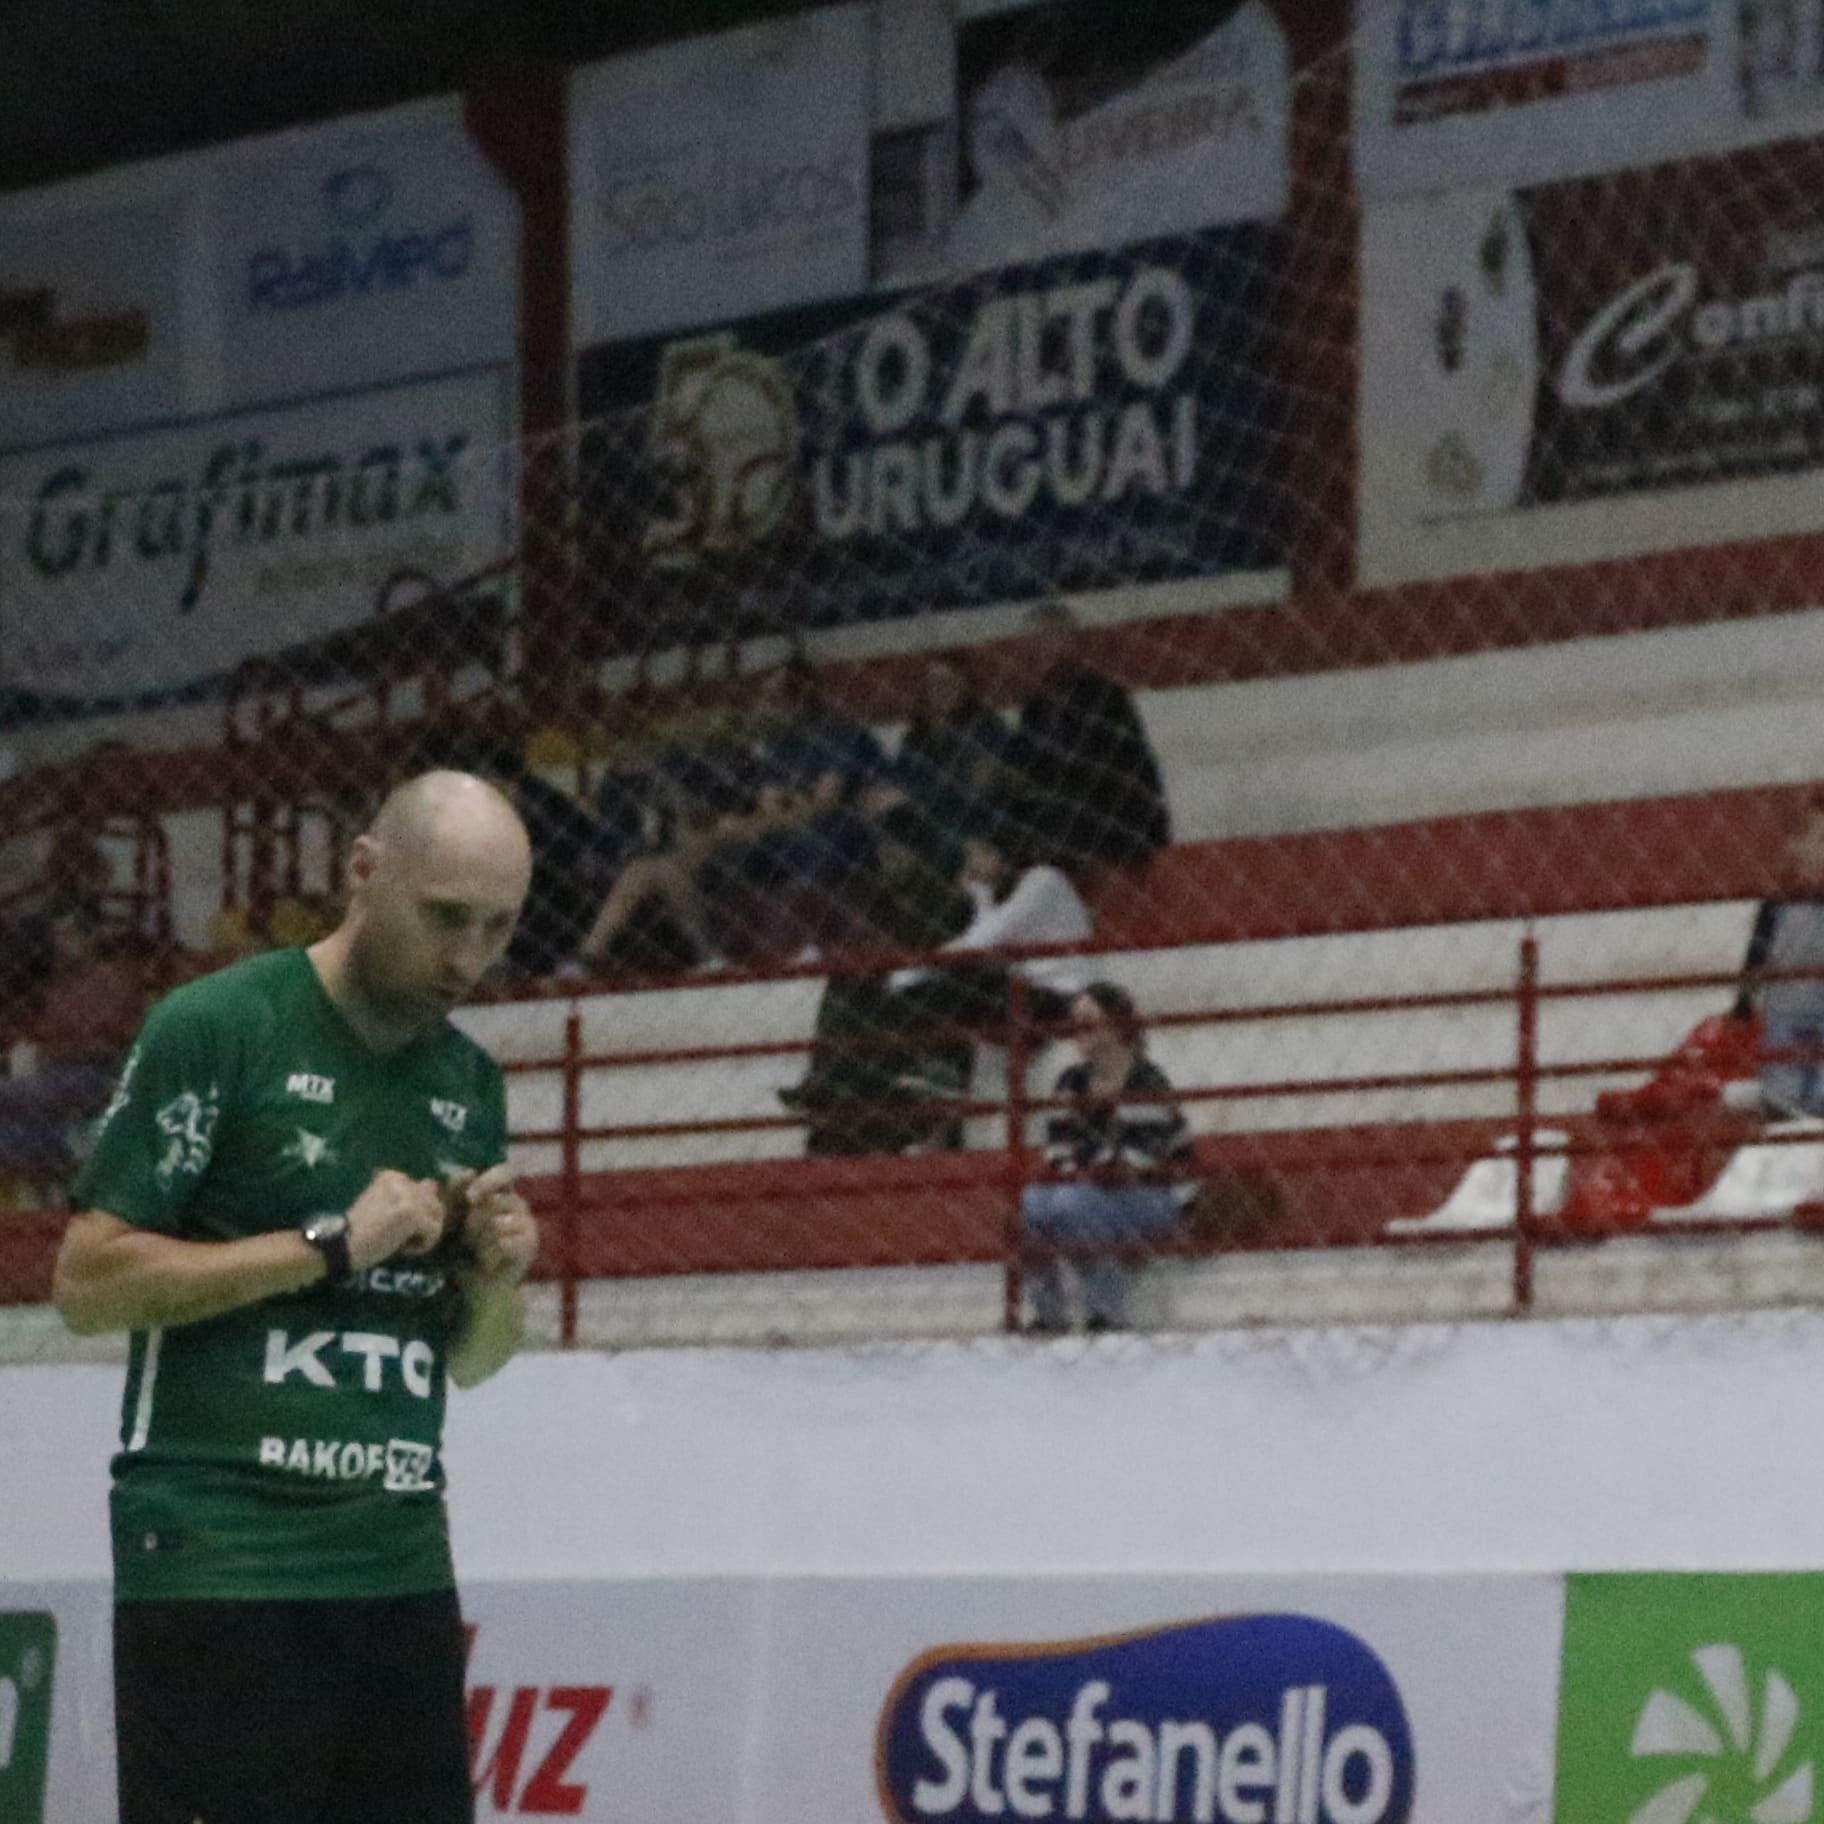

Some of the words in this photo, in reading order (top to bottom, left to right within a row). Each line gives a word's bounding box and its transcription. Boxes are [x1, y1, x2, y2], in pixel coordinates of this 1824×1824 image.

[857, 315, 928, 434] O
[938, 268, 1194, 425] ALTO
[26, 434, 470, 614] Grafimax
[810, 396, 1198, 538] URUGUAI
[463, 1622, 614, 1815] uz
